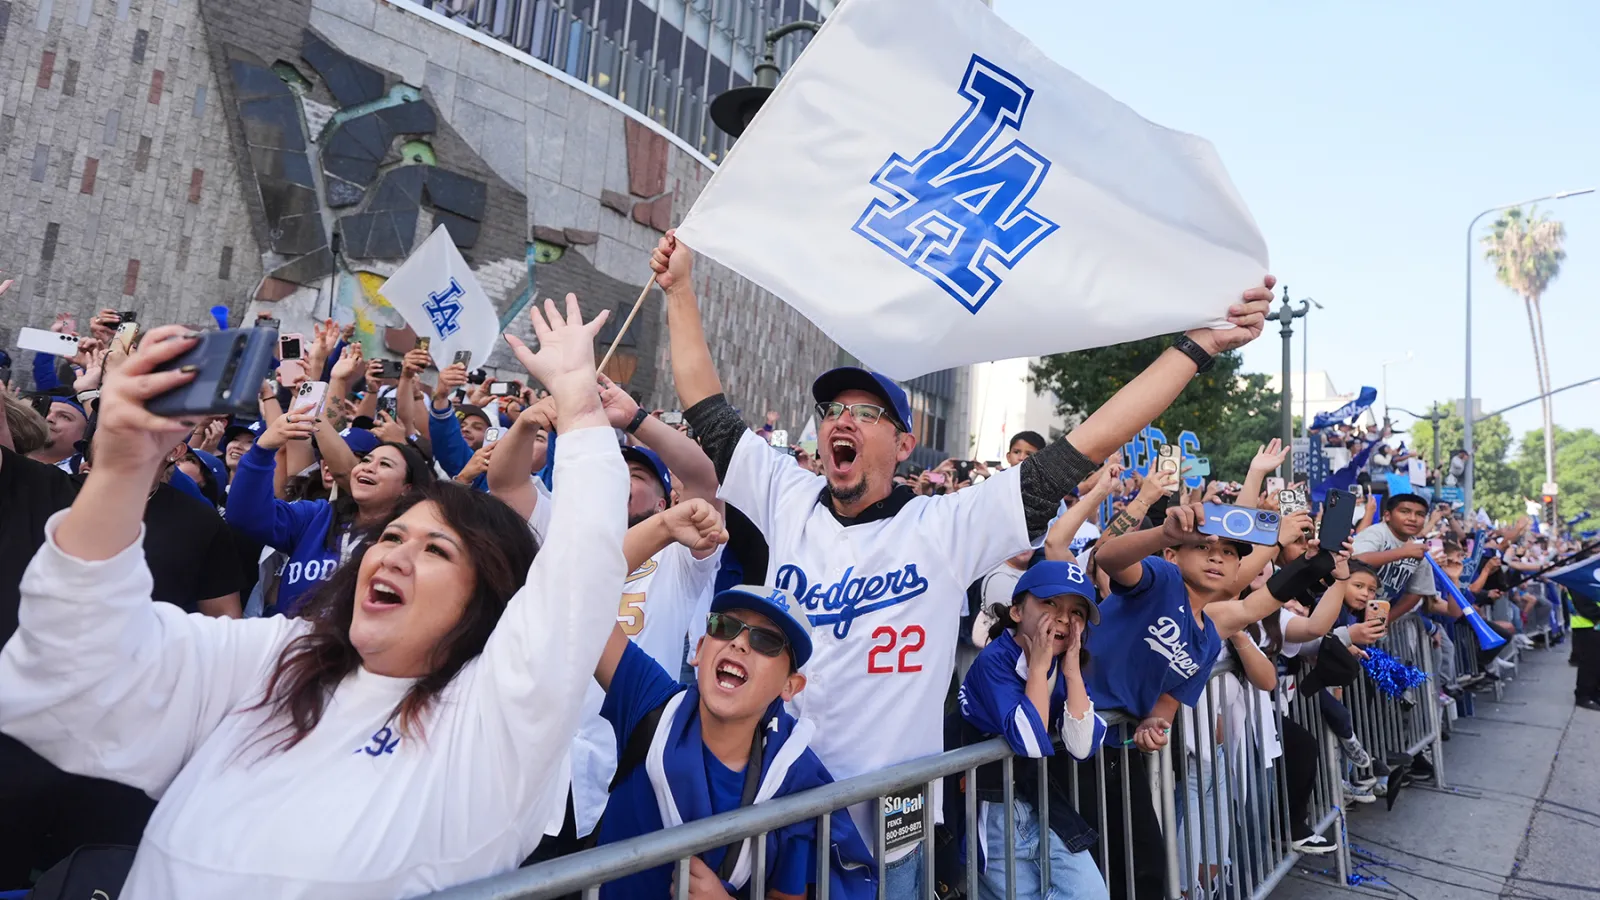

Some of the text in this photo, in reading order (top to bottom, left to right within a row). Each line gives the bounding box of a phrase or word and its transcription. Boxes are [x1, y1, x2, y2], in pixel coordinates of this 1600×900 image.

[851, 53, 1061, 315] LA
[422, 276, 466, 341] LA
[1067, 562, 1085, 584] B
[766, 588, 791, 613] LA
[775, 563, 929, 640] Dodgers
[867, 624, 926, 674] 22
[887, 816, 903, 829] FENCE
